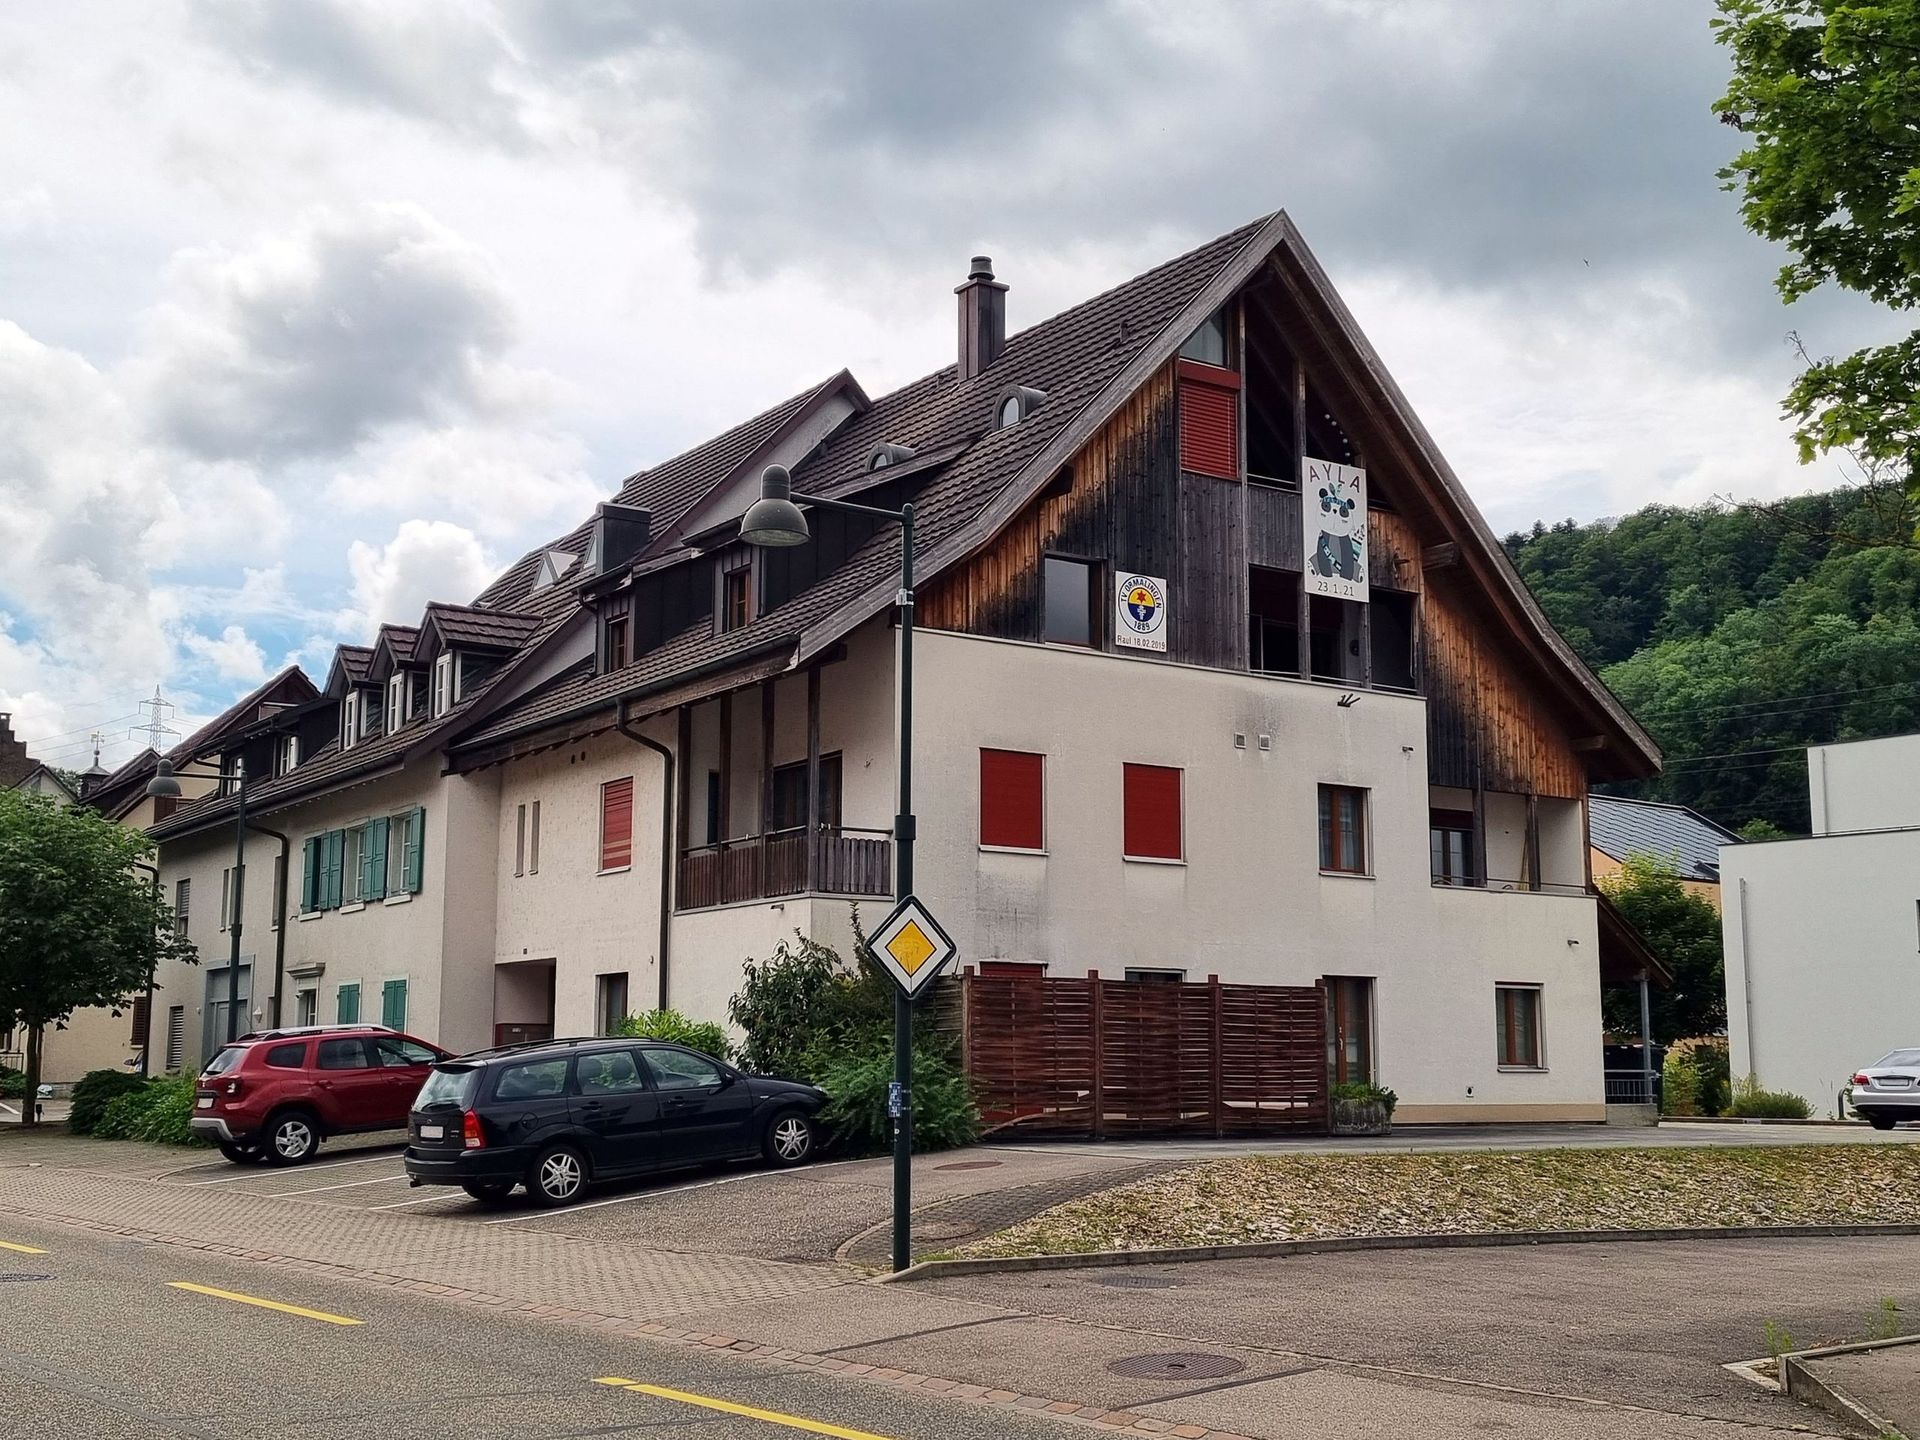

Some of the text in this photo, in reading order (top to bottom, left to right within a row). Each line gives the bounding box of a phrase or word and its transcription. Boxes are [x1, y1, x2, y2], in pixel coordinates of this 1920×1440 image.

[1309, 463, 1360, 493] AYLA
[1121, 578, 1162, 609] TV ORMALINGEN
[1133, 620, 1151, 631] 1889
[1117, 634, 1132, 644] Raul
